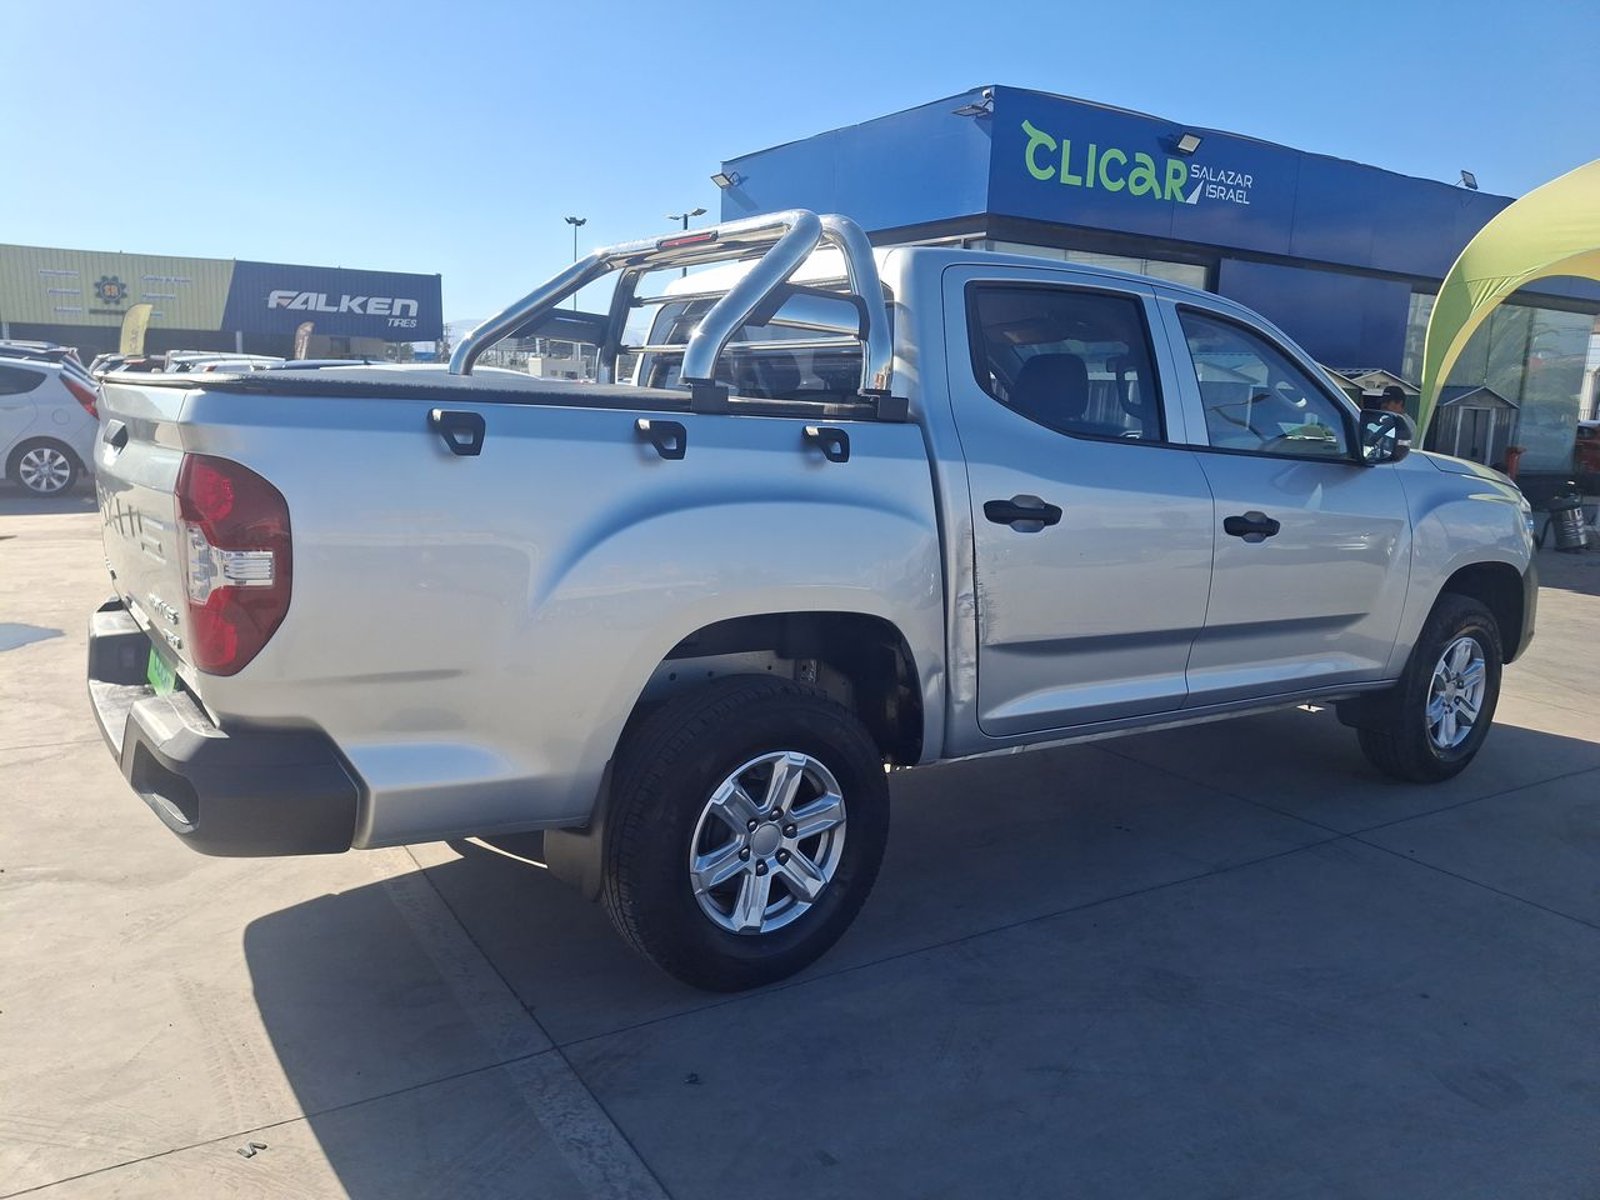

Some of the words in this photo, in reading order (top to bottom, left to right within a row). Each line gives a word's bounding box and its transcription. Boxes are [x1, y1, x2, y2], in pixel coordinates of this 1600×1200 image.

[1190, 164, 1254, 190] SALAZAR
[1205, 184, 1250, 205] ISRAEL
[267, 289, 419, 317] FALKEN
[387, 317, 418, 328] TIRES
